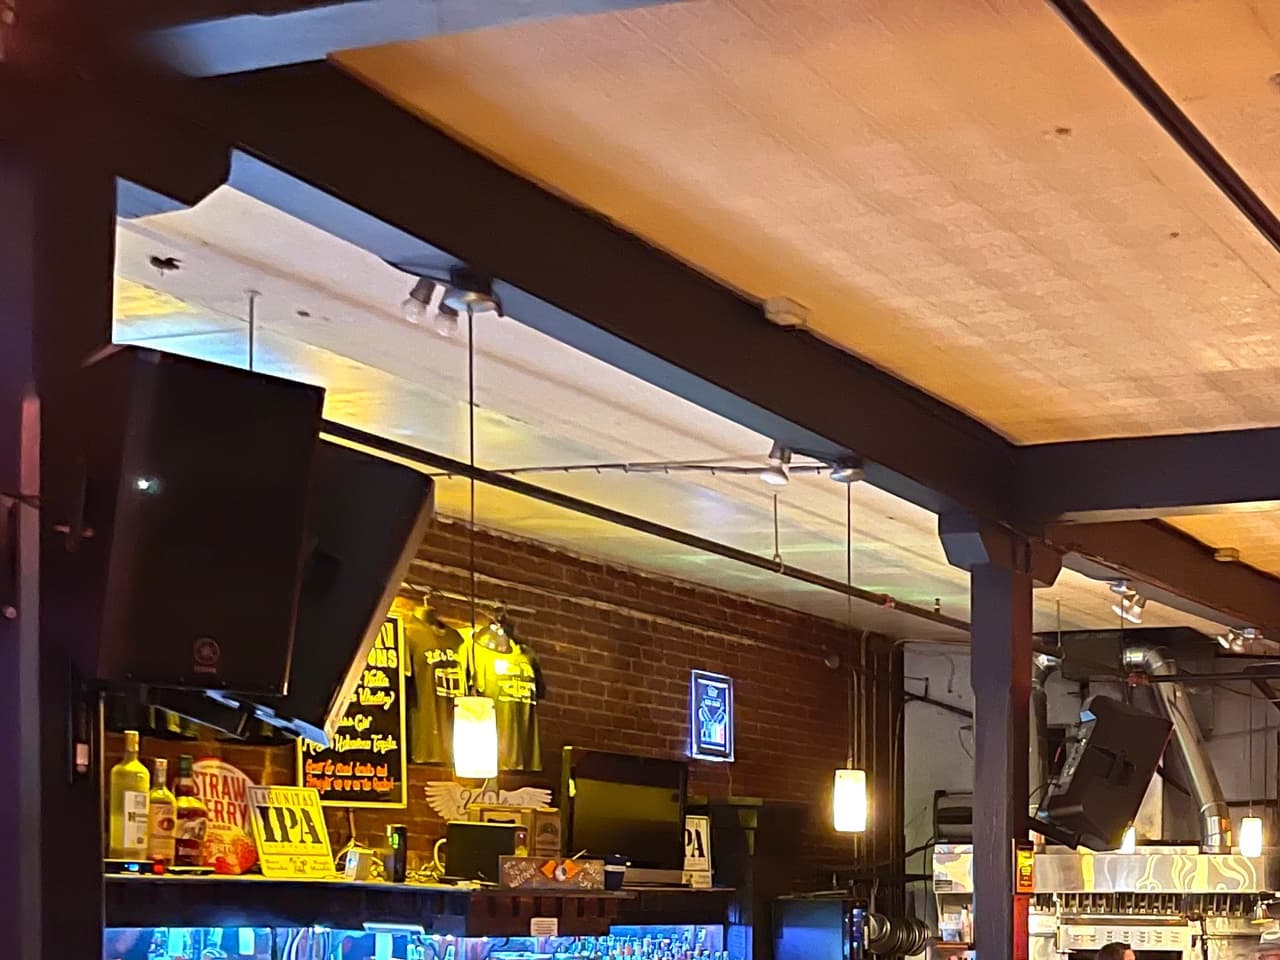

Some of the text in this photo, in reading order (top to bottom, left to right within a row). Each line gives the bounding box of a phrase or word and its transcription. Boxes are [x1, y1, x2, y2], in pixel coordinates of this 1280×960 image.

[192, 770, 247, 805] STRAW
[253, 790, 314, 807] LAGUNITAS
[207, 800, 247, 829] ERRY
[256, 805, 323, 844] IPA
[684, 828, 706, 858] PA
